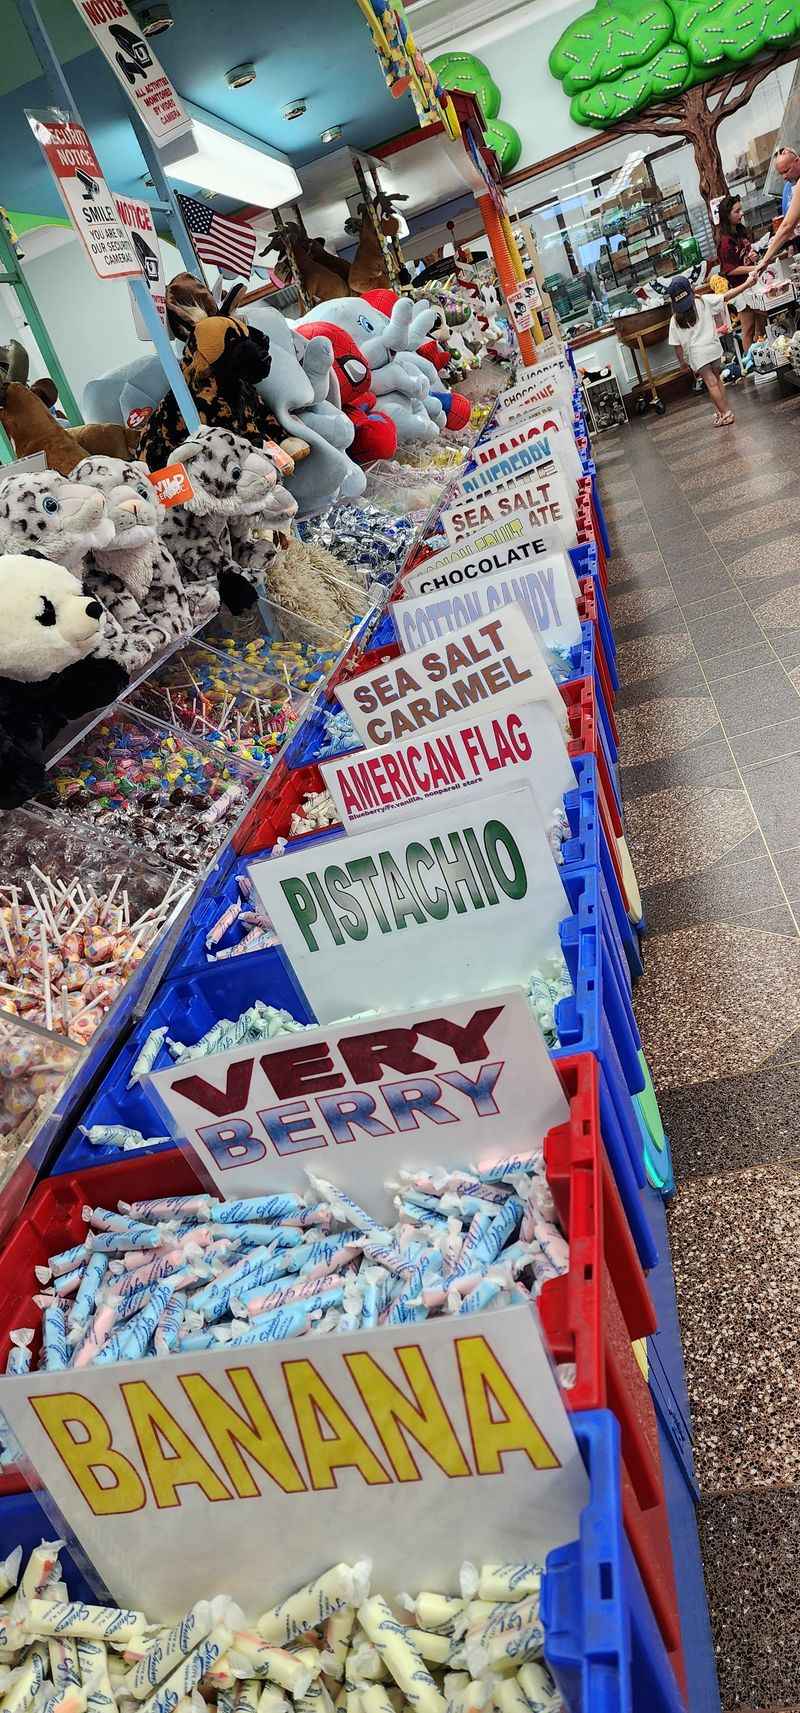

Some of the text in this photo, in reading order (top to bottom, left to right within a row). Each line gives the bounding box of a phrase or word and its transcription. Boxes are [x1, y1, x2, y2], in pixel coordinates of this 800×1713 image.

[81, 0, 128, 26] NOTICE
[48, 128, 89, 146] ECURITY
[56, 149, 95, 166] NOTICE
[82, 206, 116, 223] SMILE!
[89, 227, 105, 239] YOU
[106, 228, 118, 239] ARE
[116, 200, 152, 231] NOTICE
[91, 241, 106, 254] OUR
[451, 504, 495, 532] SEA
[498, 483, 551, 517] SALT
[420, 539, 547, 593] CHOCOLATE
[353, 619, 505, 714] SEA SALT
[366, 656, 533, 745] CARAMEL
[336, 713, 532, 813] AMERICAN FLAG
[279, 820, 528, 952] PISTACHIO
[171, 1004, 505, 1118] VERY
[195, 1061, 505, 1170] BERRY
[27, 1335, 562, 1515] BANANA
